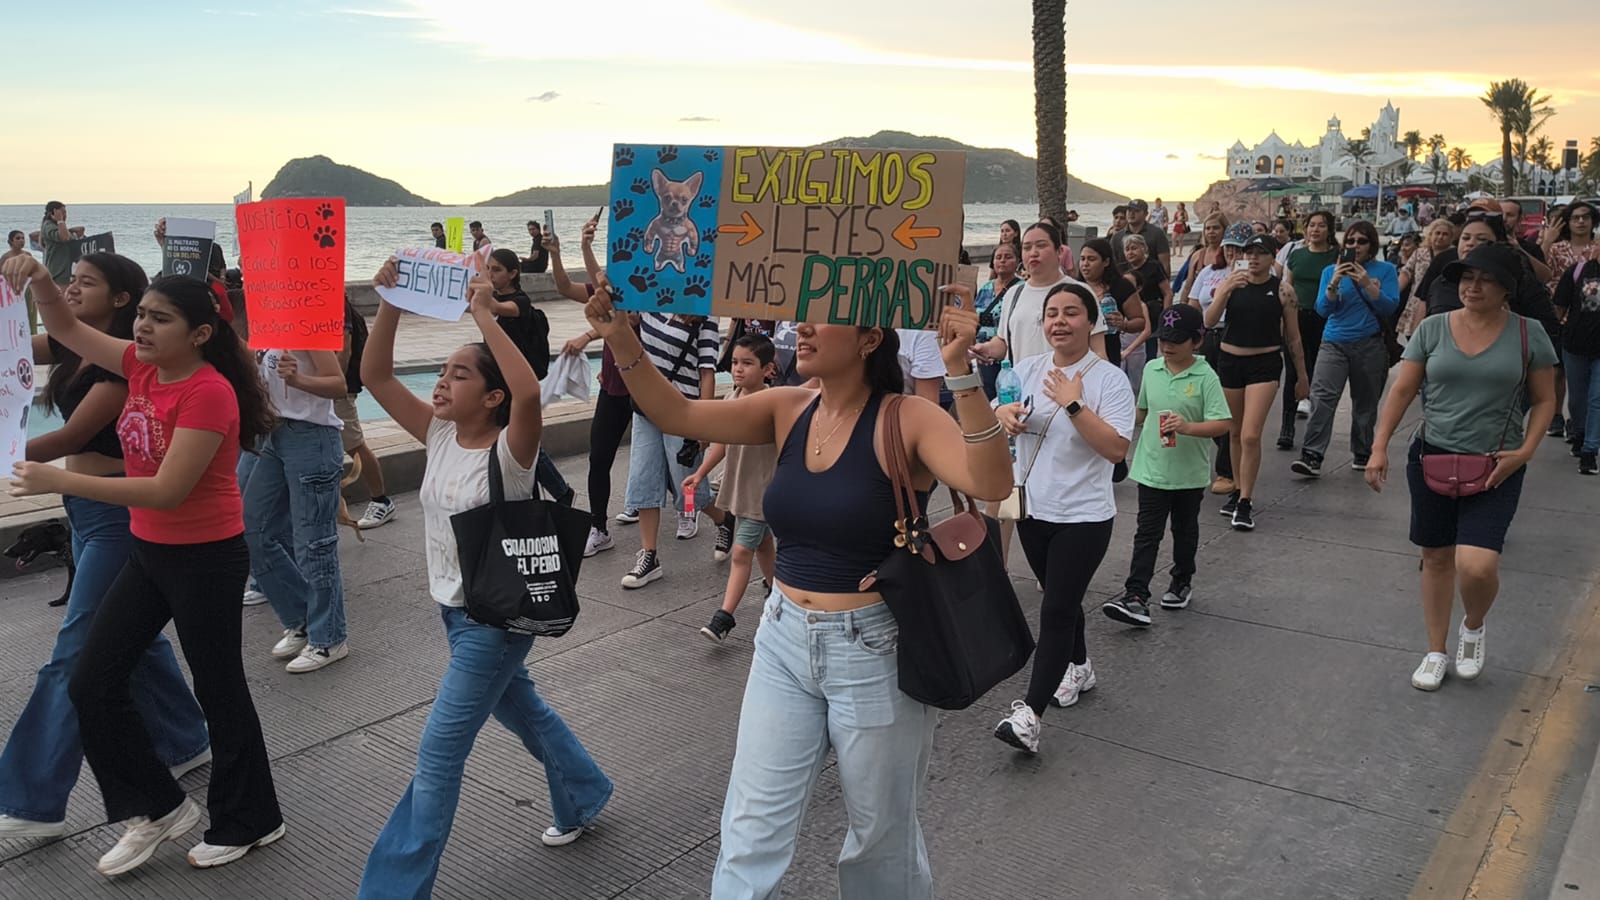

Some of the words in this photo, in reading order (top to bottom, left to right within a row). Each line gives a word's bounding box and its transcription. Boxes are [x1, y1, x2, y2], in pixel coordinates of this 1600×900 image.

[733, 147, 937, 210] EXIGIMOS
[242, 208, 310, 232] Justicia
[772, 205, 886, 256] LEYES
[725, 258, 786, 306] MÁS
